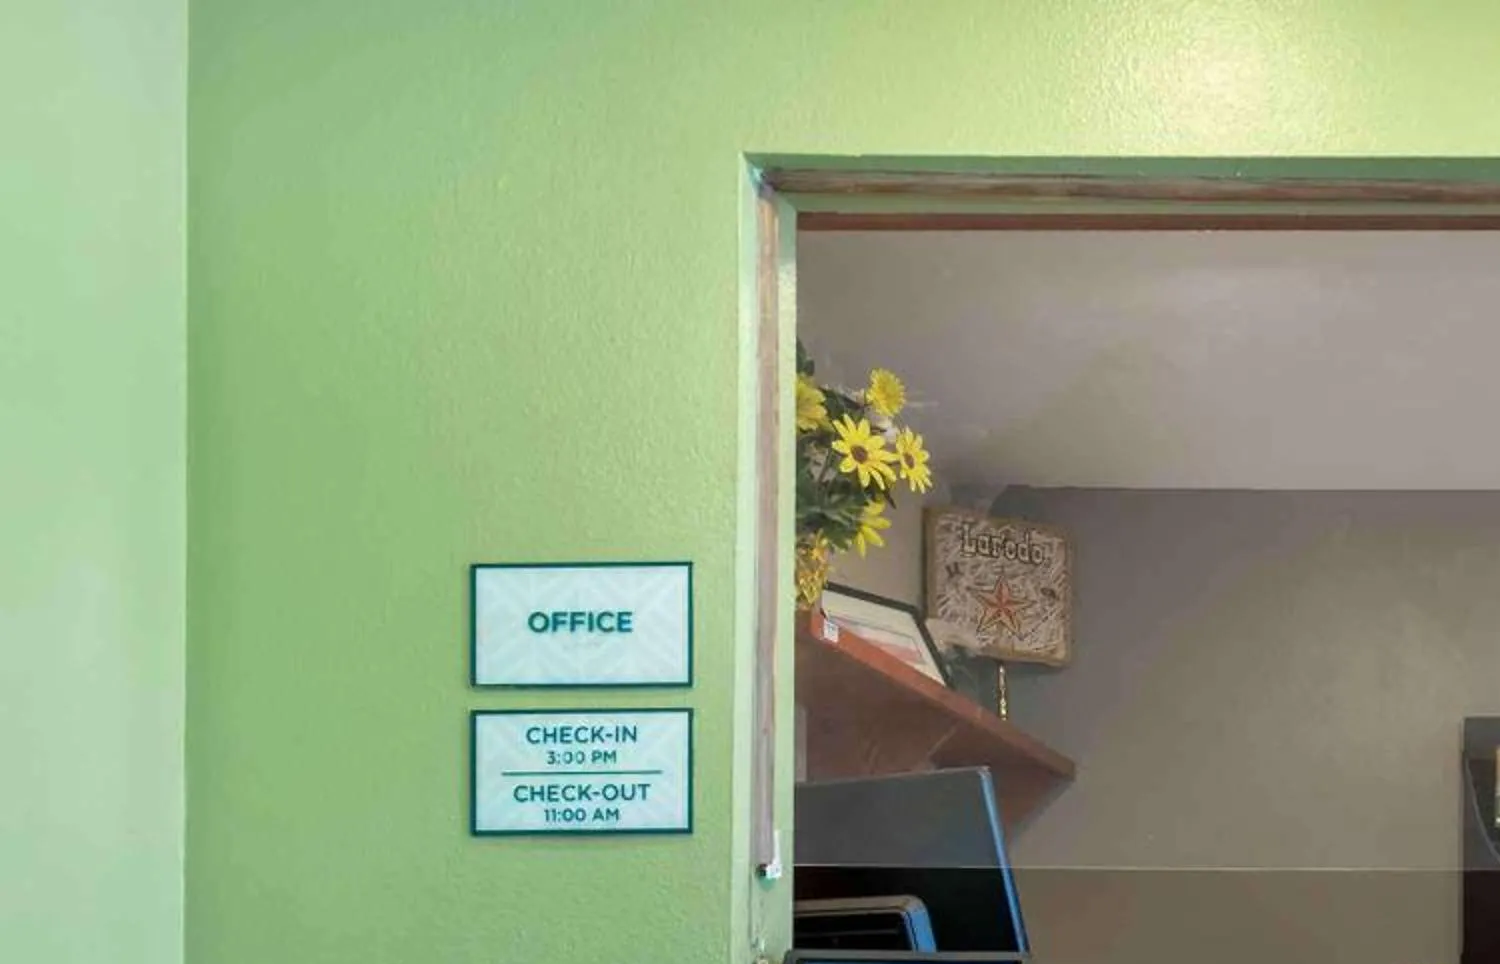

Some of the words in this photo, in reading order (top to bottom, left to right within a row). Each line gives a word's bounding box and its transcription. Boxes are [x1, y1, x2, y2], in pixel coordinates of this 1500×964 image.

[961, 522, 1044, 565] Laredo
[527, 611, 634, 633] OFFICE
[525, 725, 638, 744] CHECK-IN
[546, 751, 586, 765] 3:00
[591, 750, 617, 764] PM
[512, 783, 651, 803] CHECK-OUT
[544, 809, 587, 822] 11:00
[592, 808, 620, 822] AM
